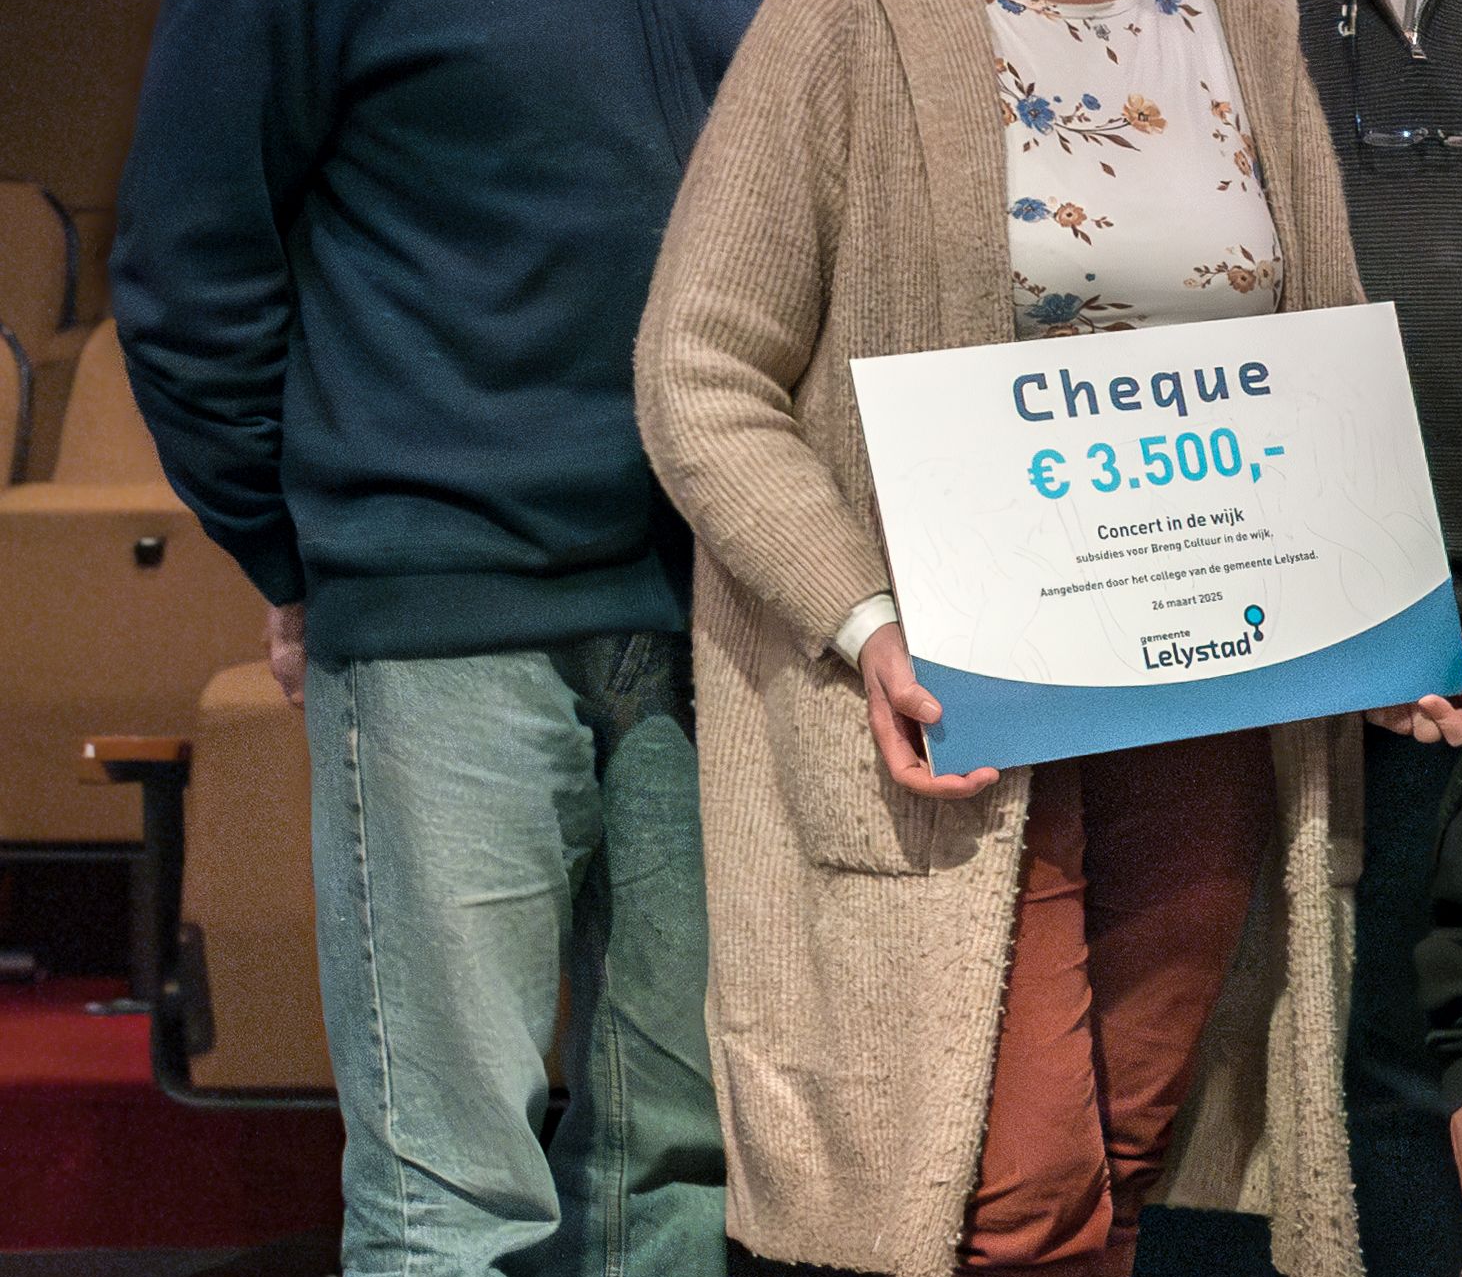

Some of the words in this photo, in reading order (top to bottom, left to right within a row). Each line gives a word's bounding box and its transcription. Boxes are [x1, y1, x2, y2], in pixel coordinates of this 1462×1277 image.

[1012, 361, 1272, 423] Cheque
[1026, 448, 1071, 500] €
[1086, 427, 1285, 494] 3.500,-
[1097, 518, 1164, 541] Concert
[1166, 515, 1183, 532] in
[1186, 513, 1207, 529] de
[1209, 507, 1245, 527] wijk
[1075, 550, 1125, 564] subsidies
[1125, 546, 1149, 557] voor
[1150, 542, 1183, 554] Breng
[1183, 536, 1222, 549] Cultuur
[1223, 534, 1235, 544] in
[1235, 531, 1249, 542] de
[1040, 580, 1105, 598] Aangeboden
[1105, 577, 1130, 589] door
[1131, 574, 1149, 585] het
[1149, 569, 1187, 583] college
[1188, 567, 1208, 577] van
[1208, 564, 1222, 574] de
[1222, 557, 1273, 574] gemeente
[1151, 599, 1165, 611] 26
[1165, 595, 1198, 609] maart
[1197, 591, 1224, 604] 2025
[1139, 629, 1191, 647] gemeente
[1142, 631, 1252, 671] Lelystad
